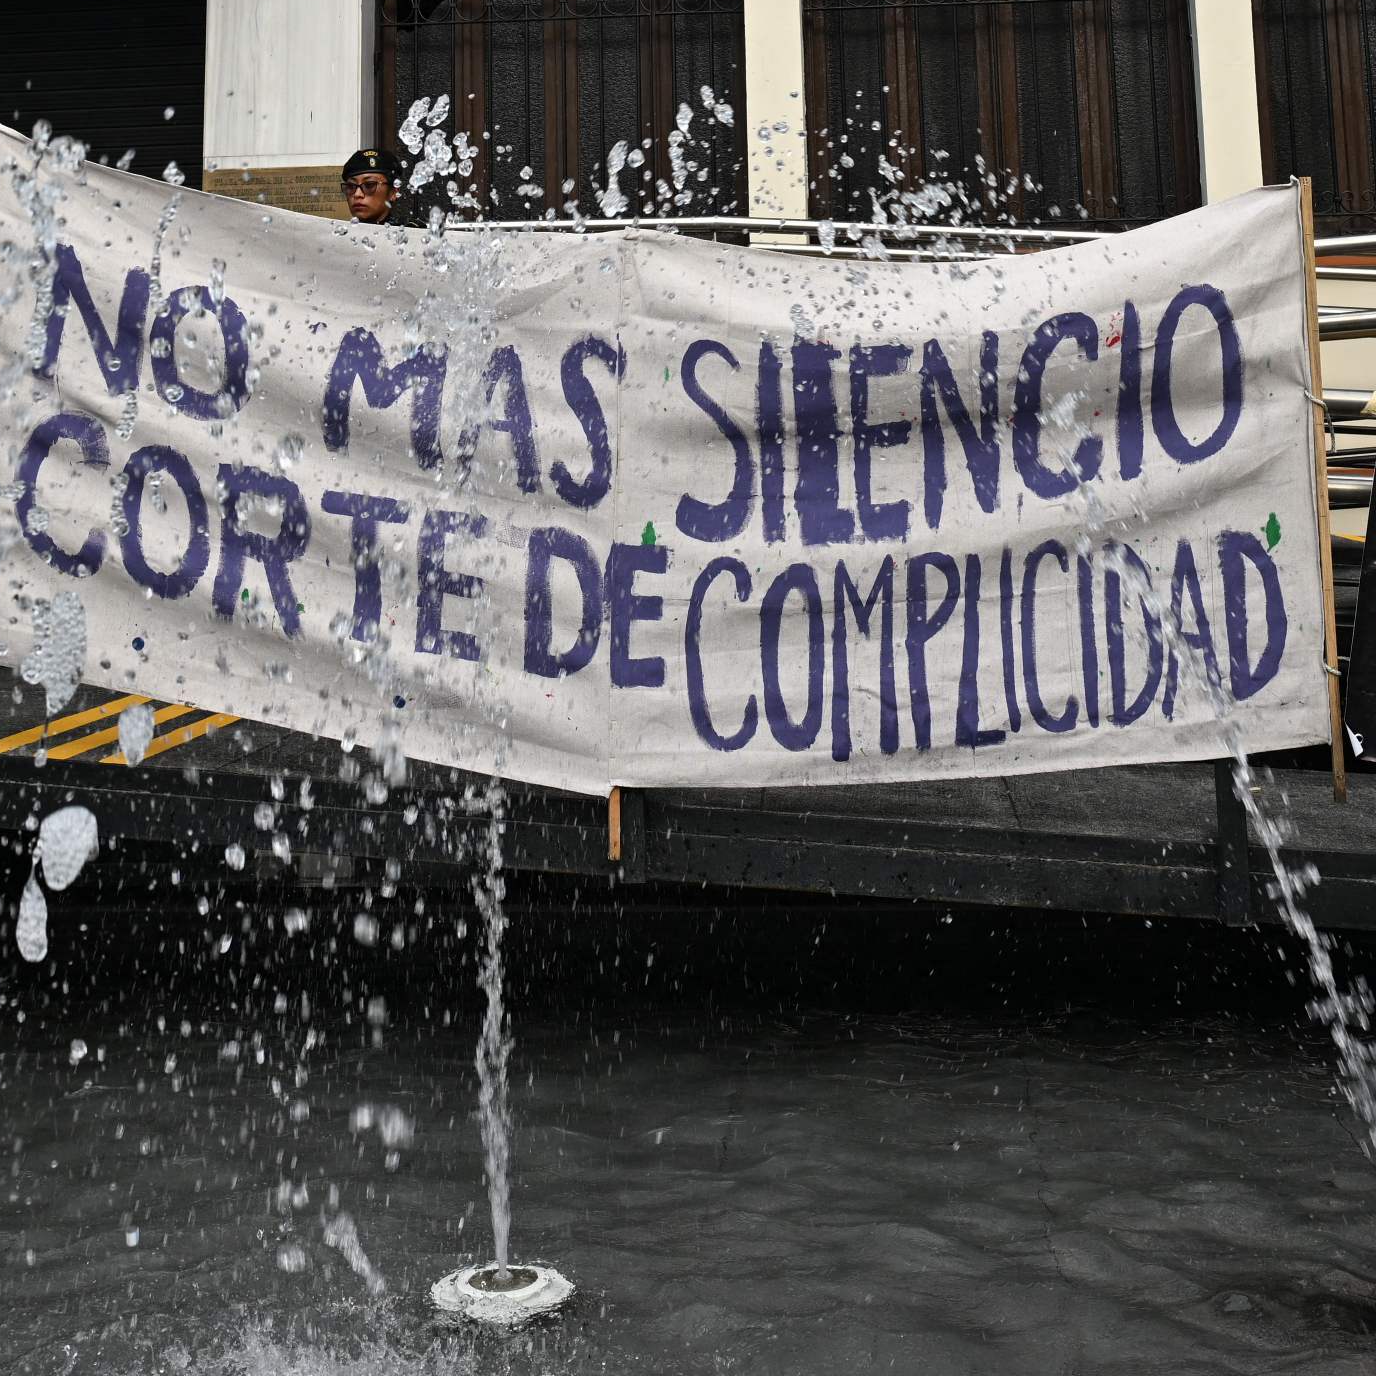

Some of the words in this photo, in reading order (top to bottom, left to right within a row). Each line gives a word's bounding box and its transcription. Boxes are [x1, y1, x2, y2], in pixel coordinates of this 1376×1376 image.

[31, 242, 252, 421] NO
[324, 327, 625, 511] MAS
[676, 284, 1245, 545] SILENCIO
[14, 411, 488, 661] CORTE
[524, 526, 670, 689] DE
[684, 529, 1287, 761] COMPLICIDAD
